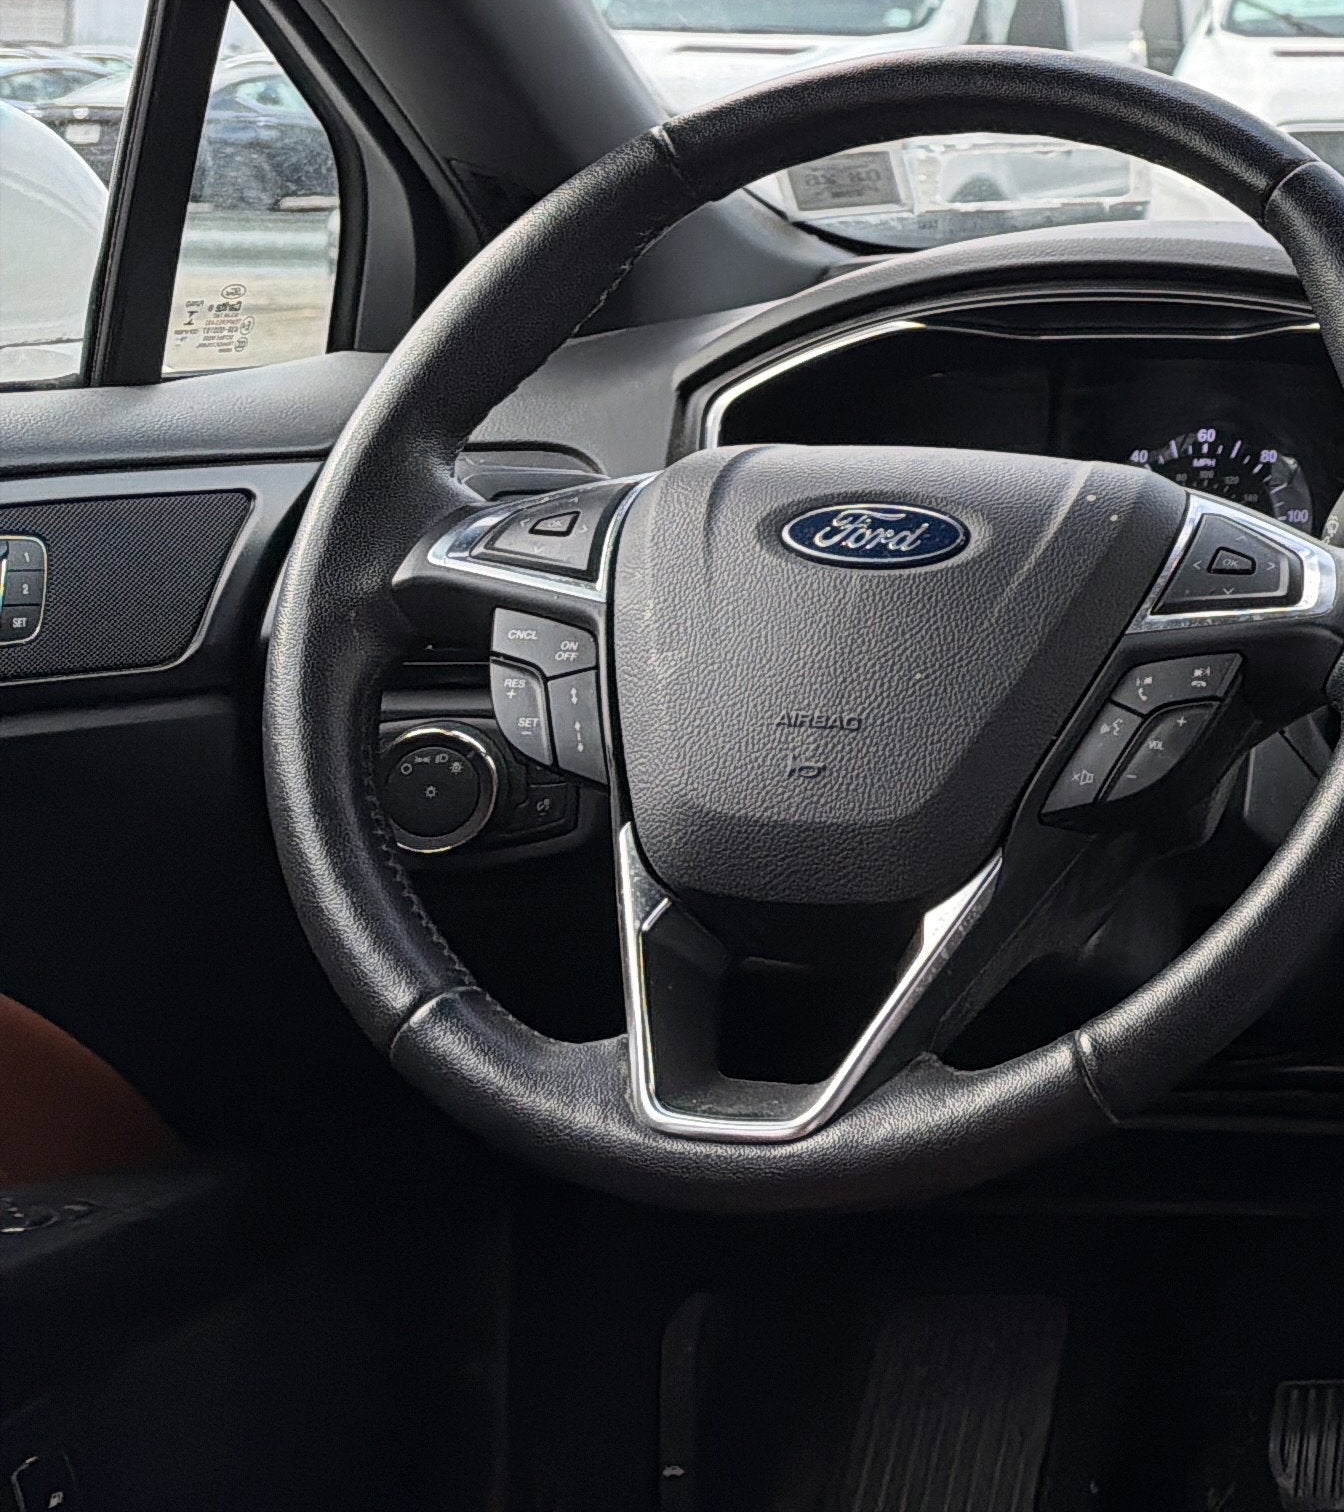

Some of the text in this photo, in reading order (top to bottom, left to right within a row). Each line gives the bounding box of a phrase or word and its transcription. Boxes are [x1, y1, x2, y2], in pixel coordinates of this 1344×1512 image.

[1197, 428, 1217, 443] 60
[1130, 449, 1149, 463] 40
[1259, 449, 1278, 464] 80
[1192, 458, 1216, 468] MPH
[1287, 509, 1309, 523] 100
[813, 508, 931, 553] Ford
[24, 552, 30, 563] 1
[1222, 558, 1239, 568] OK
[22, 583, 29, 595] 2
[12, 617, 28, 628] SET
[507, 629, 539, 641] CNCL
[560, 640, 579, 651] ON
[554, 651, 579, 662] OFF
[503, 678, 526, 689] RES
[517, 717, 540, 729] SET
[773, 708, 864, 732] AIRBAG
[1148, 740, 1165, 751] VOL
